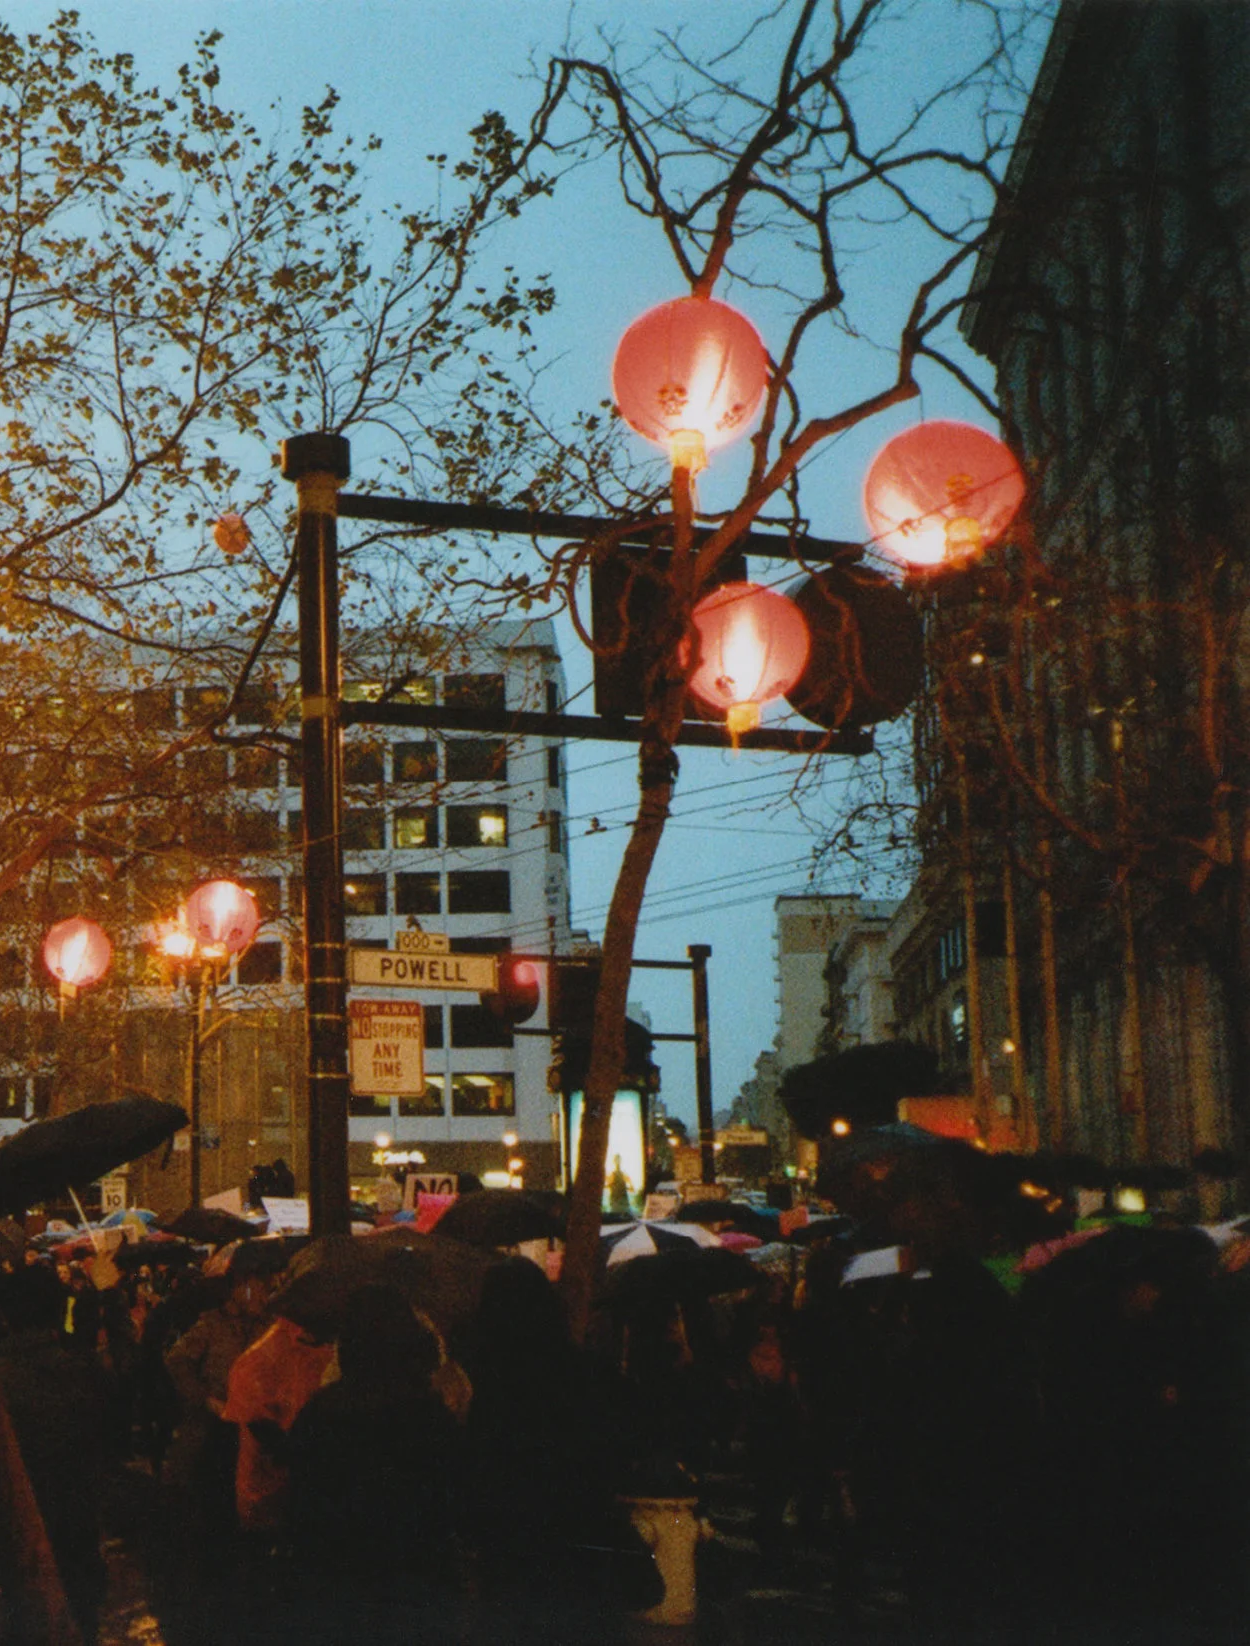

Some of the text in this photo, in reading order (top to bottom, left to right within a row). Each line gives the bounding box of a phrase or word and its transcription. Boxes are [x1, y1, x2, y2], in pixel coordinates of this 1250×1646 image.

[380, 957, 468, 983] POWELL
[352, 1018, 419, 1038] NO STOPPING
[373, 1043, 400, 1058] ANY
[372, 1061, 403, 1078] TIME
[106, 1194, 121, 1206] 10
